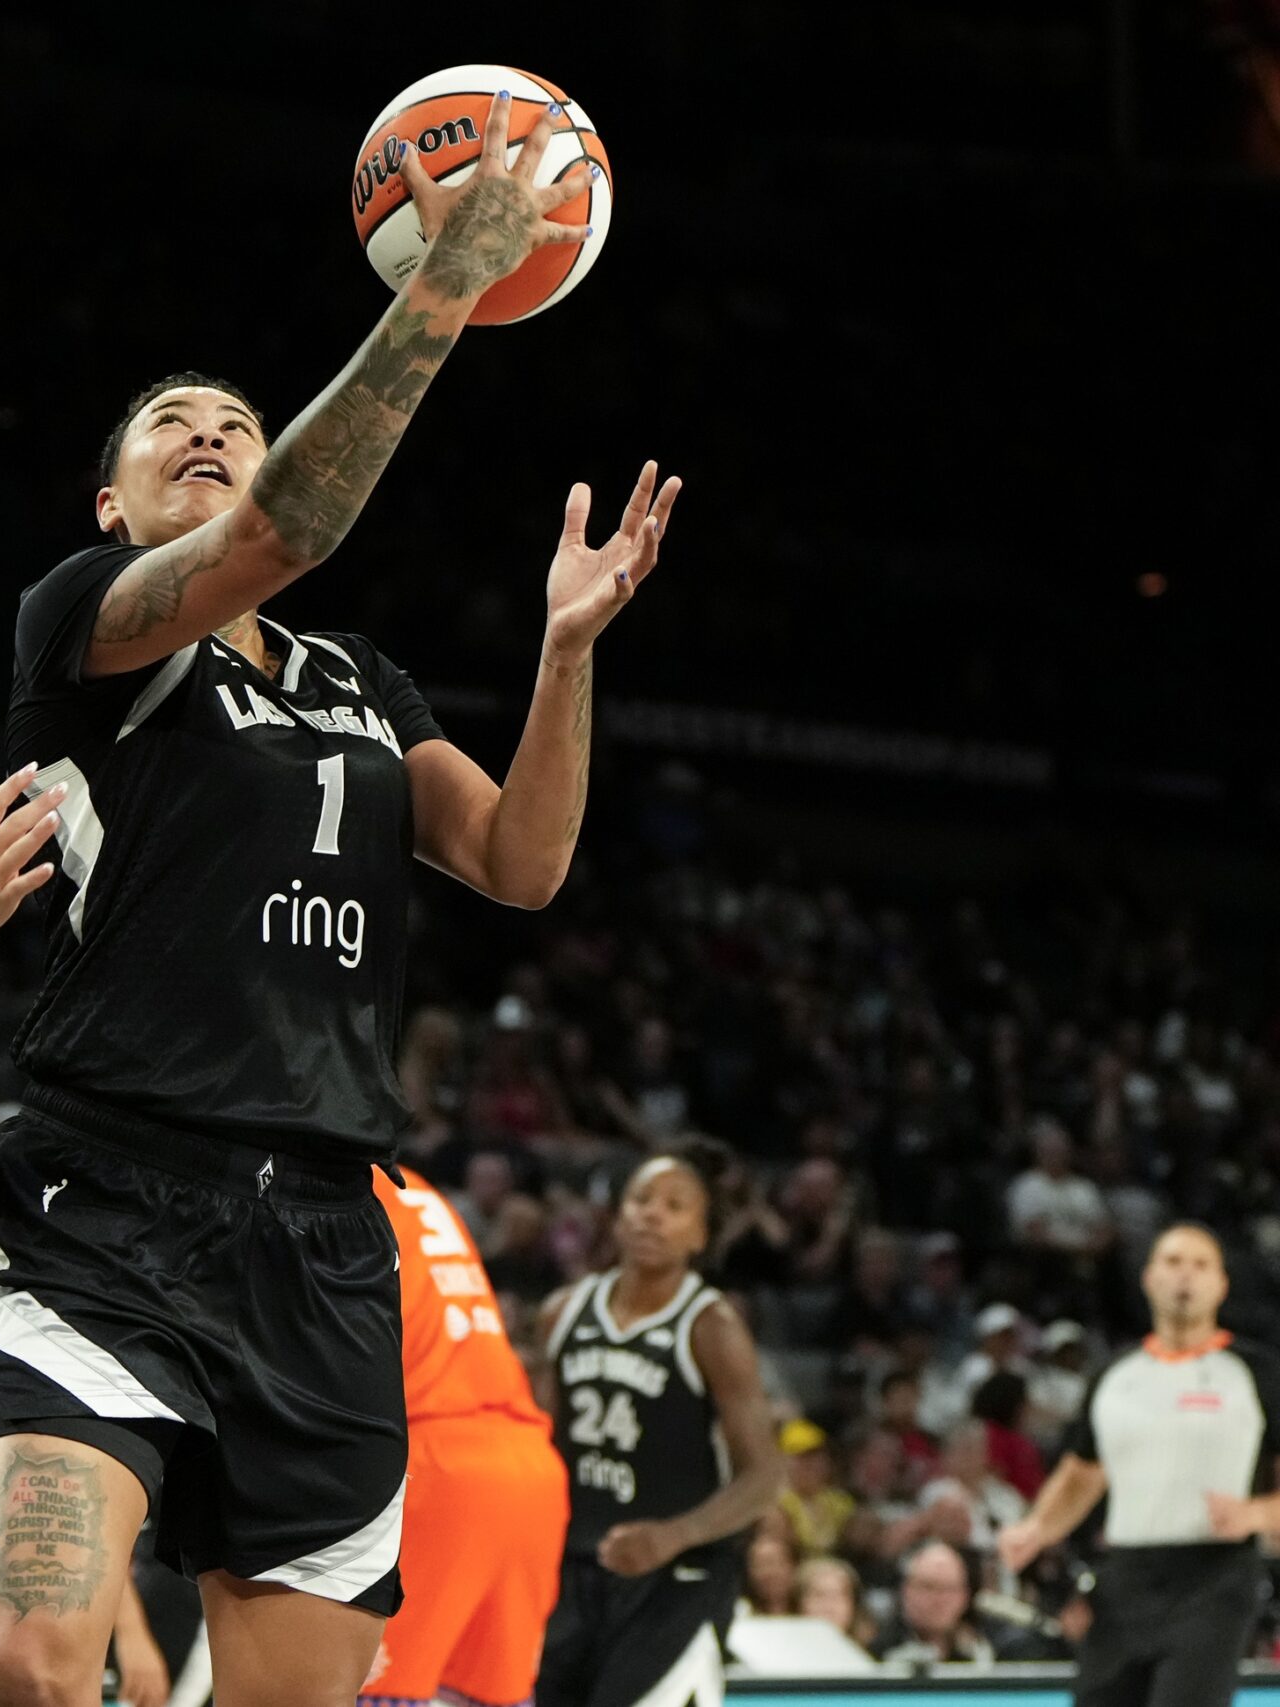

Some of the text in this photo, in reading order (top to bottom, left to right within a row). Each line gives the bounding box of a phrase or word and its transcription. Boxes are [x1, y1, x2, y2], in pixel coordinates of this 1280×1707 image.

[352, 115, 480, 216] Wilon
[215, 683, 296, 730] LAS
[312, 753, 345, 856] 1
[262, 878, 366, 969] ring
[569, 1385, 642, 1452] 24
[12, 1491, 34, 1503] ALL
[29, 1475, 59, 1488] CAN
[577, 1450, 636, 1504] ring
[7, 1516, 86, 1533] CHRIST WHO
[22, 1502, 83, 1520] THROUGH
[36, 1543, 57, 1556] ME
